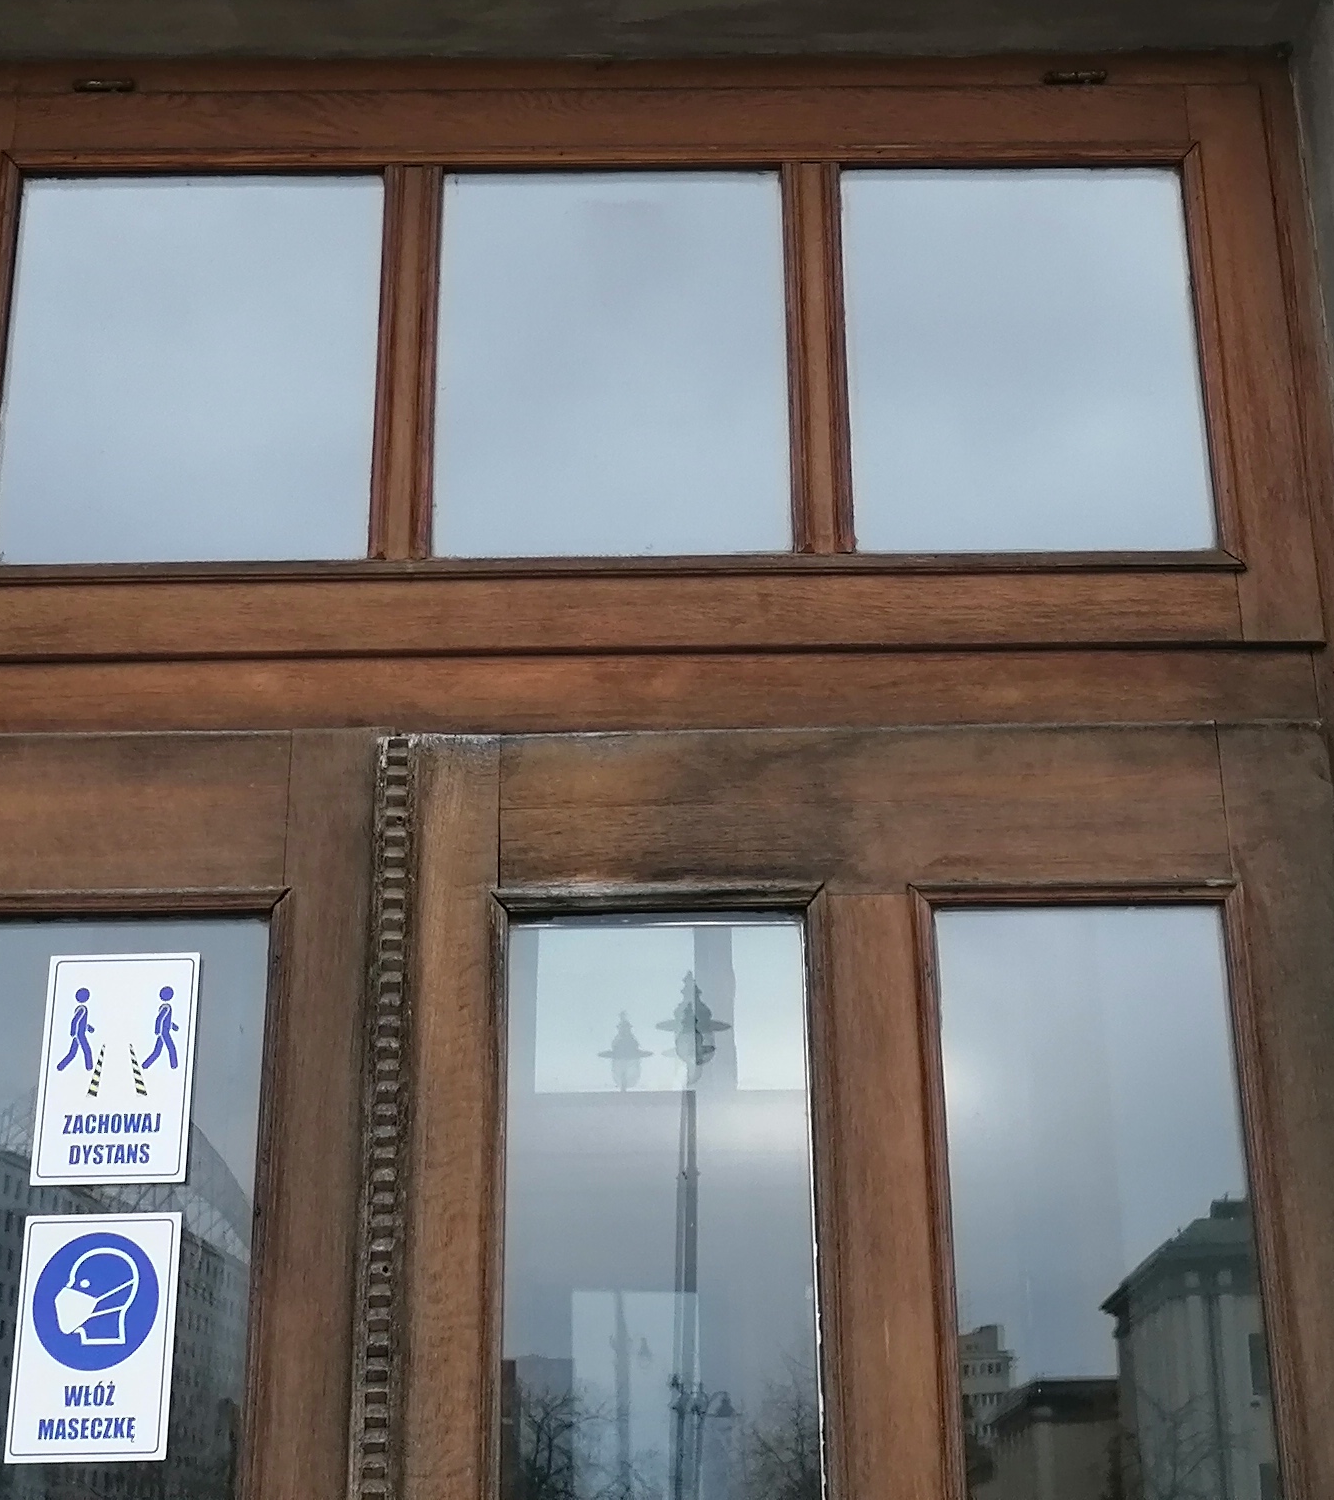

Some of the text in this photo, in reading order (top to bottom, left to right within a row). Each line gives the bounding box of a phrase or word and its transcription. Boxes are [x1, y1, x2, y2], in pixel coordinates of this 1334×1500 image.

[63, 1112, 161, 1135] ZACHOWAJ
[69, 1143, 150, 1165] DYSTANS
[64, 1380, 116, 1407] WŁÓŻ
[37, 1416, 136, 1443] MASECZKĘ
